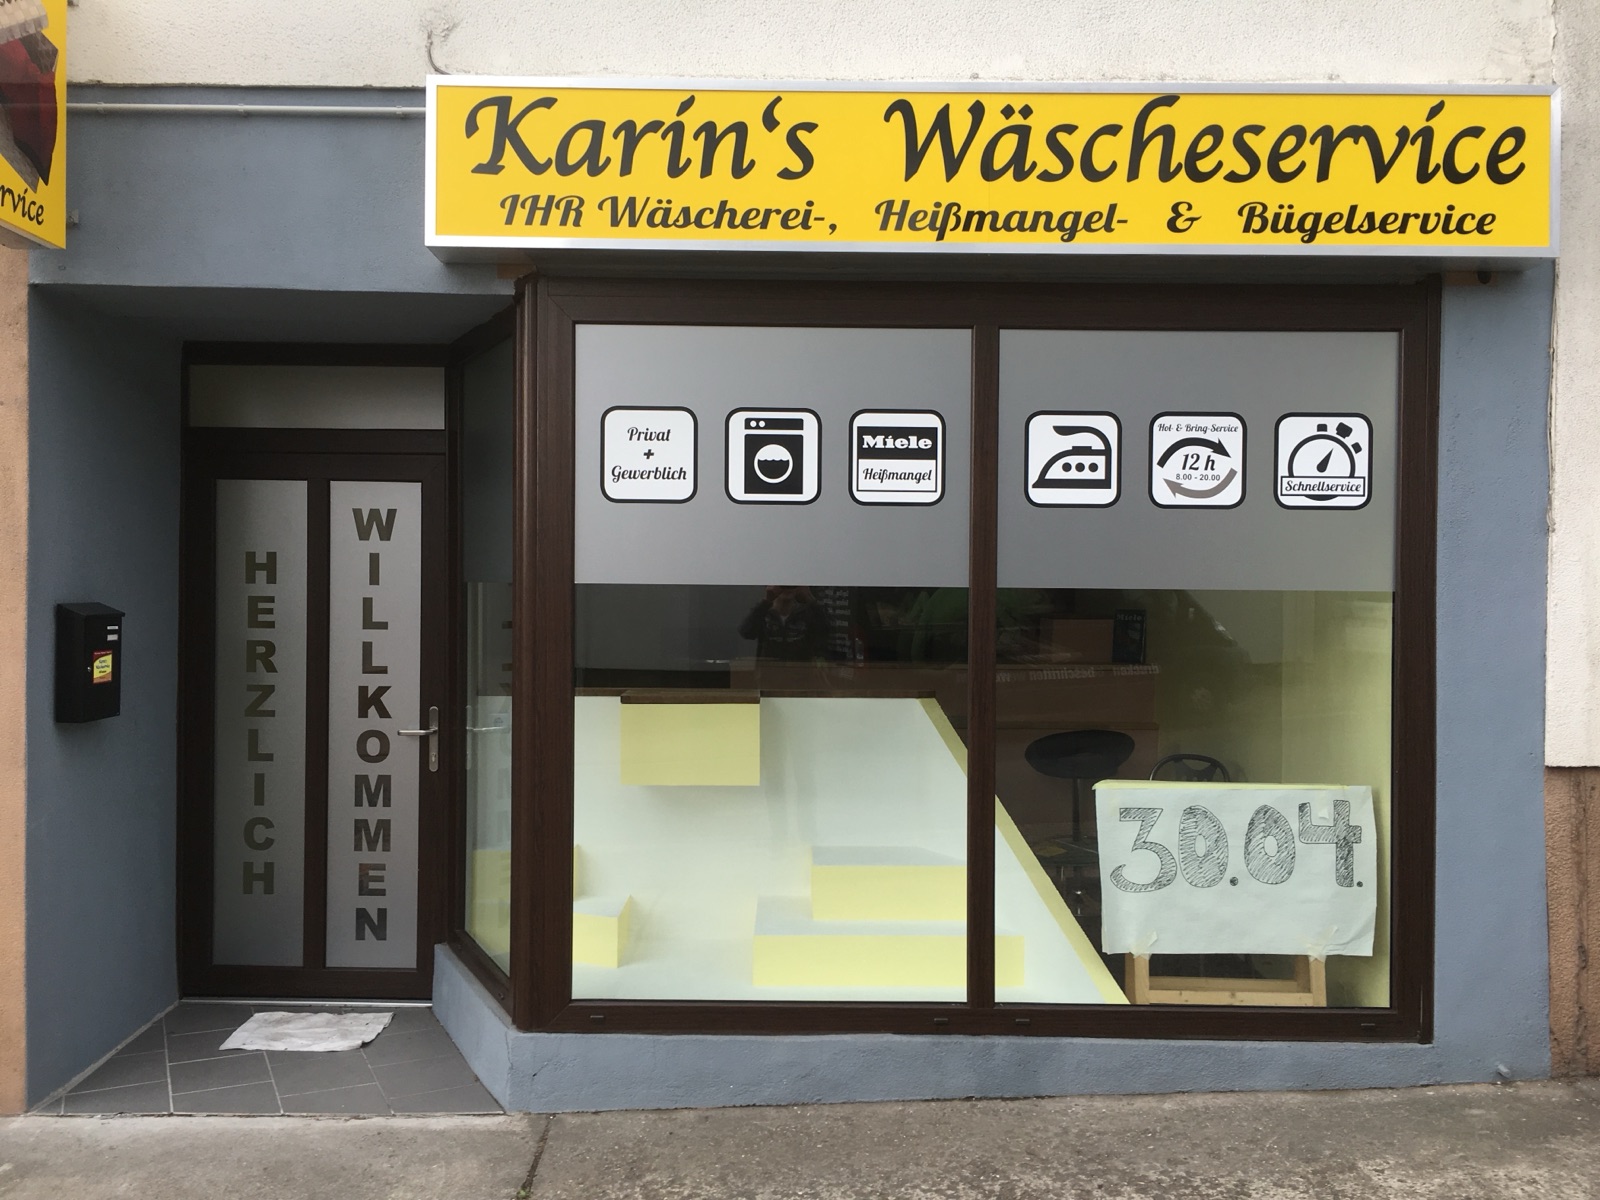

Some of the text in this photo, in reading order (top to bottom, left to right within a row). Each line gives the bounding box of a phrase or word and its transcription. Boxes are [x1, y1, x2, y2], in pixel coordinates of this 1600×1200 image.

[465, 94, 1526, 185] Karin's Wäscheservice
[500, 194, 1496, 244] IHR Wäscherei-, Heißmangel- & Bügelservice
[627, 426, 671, 442] Privat
[1176, 423, 1183, 432] &
[862, 435, 933, 449] Miele
[1182, 453, 1216, 471] 12 h
[612, 465, 687, 483] Gewerblich
[862, 467, 932, 485] Heißmangel
[1176, 473, 1192, 481] 8.00
[1200, 473, 1221, 482] 20.00
[1284, 480, 1362, 493] Schnellservice
[242, 551, 278, 895] HERZLICH
[352, 508, 398, 941] WILLKOMMEN
[1110, 800, 1364, 893] 30.04.
